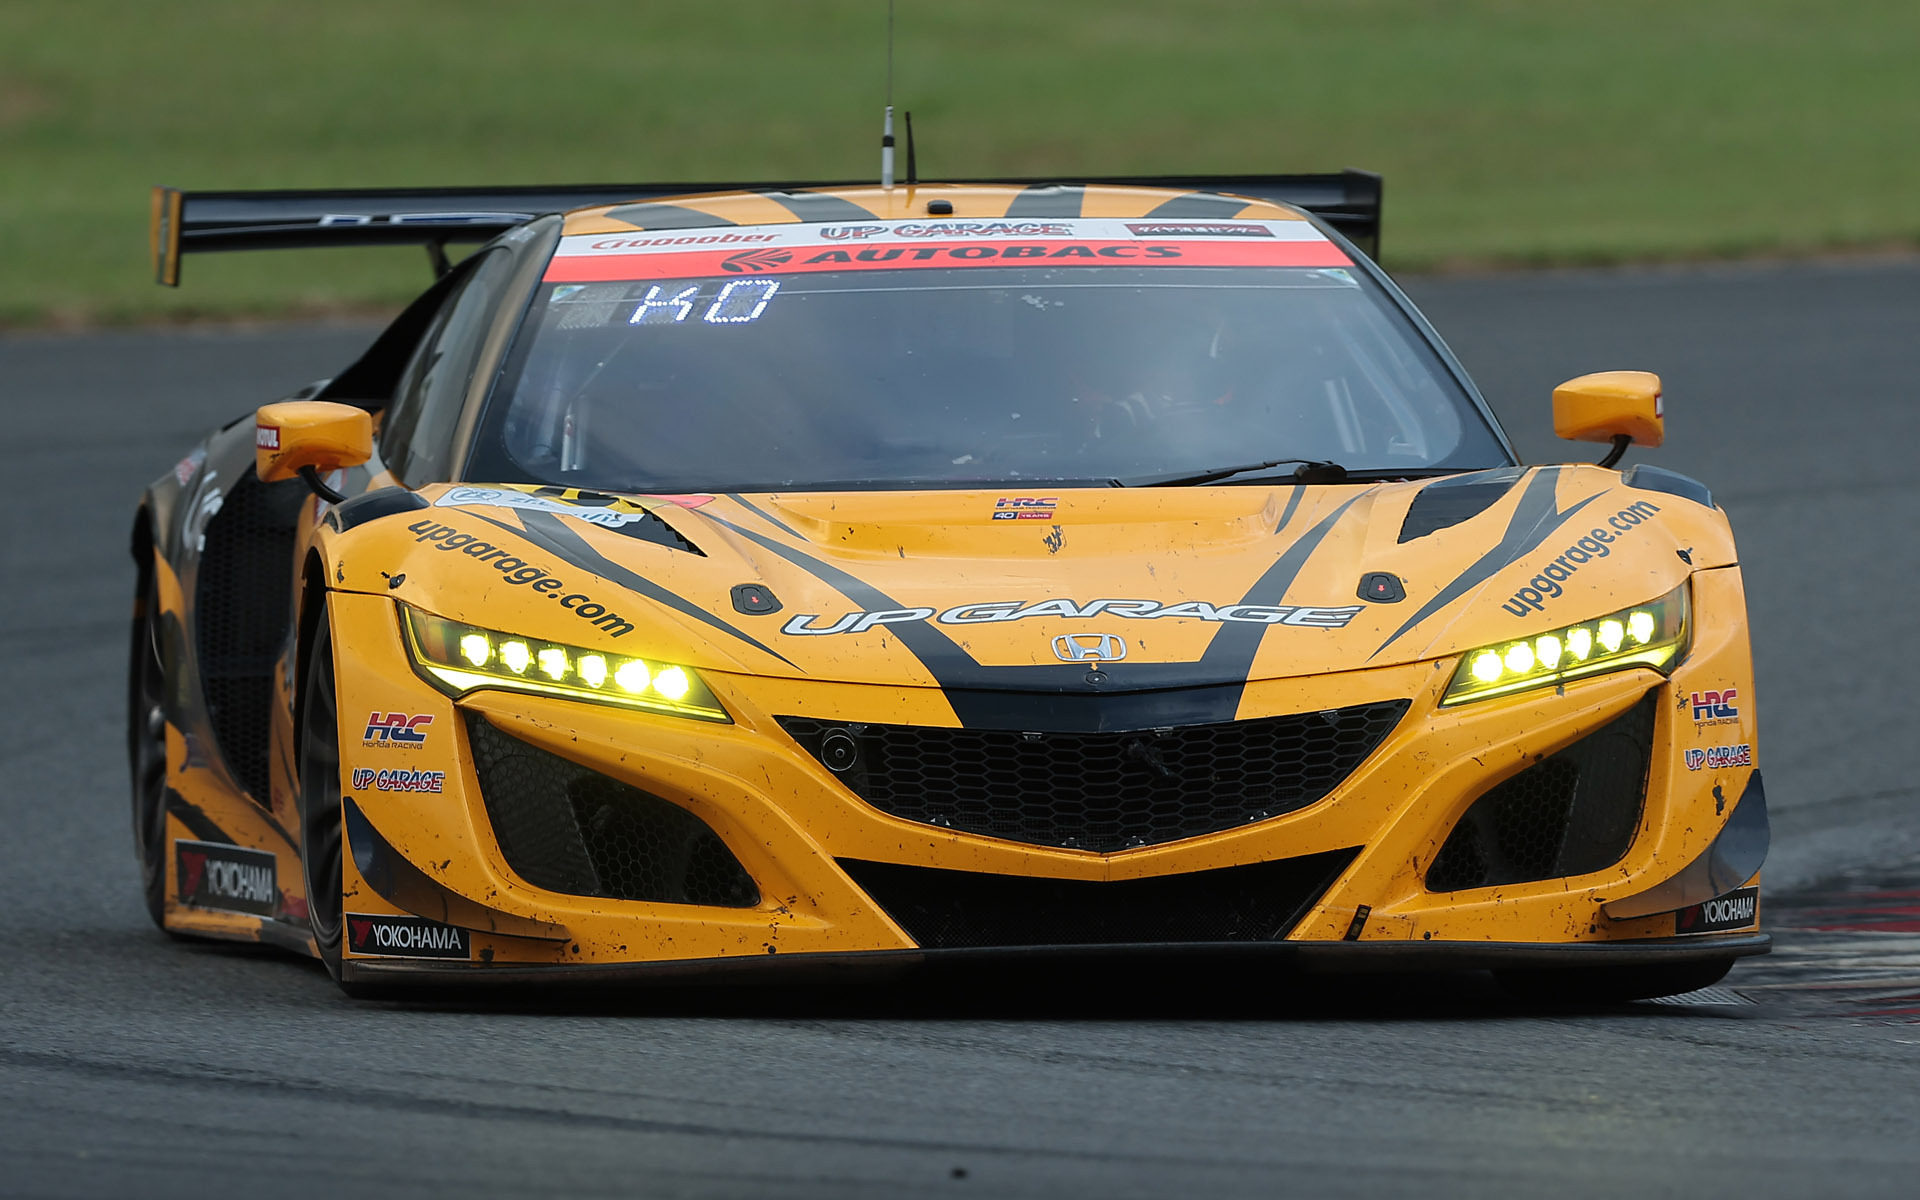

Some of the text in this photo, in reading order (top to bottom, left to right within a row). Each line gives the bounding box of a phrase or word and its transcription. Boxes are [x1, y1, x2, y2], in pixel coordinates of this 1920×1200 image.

[591, 233, 782, 250] Croooober
[819, 222, 1074, 241] UP GARAGE
[800, 245, 1183, 263] AUTOBACS
[996, 498, 1058, 507] HRC
[1501, 500, 1661, 618] upgarage.com
[407, 520, 635, 638] upgarage.com
[780, 599, 1367, 636] UP GARAGE
[1691, 688, 1739, 720] HRC
[363, 712, 434, 743] HRC
[1685, 744, 1752, 771] UP GARAGE
[353, 768, 445, 793] UP GARAGE
[206, 860, 273, 902] YOKOHAMA
[1702, 897, 1754, 923] YOKOHAMA
[372, 924, 462, 950] YOKOHAMA
